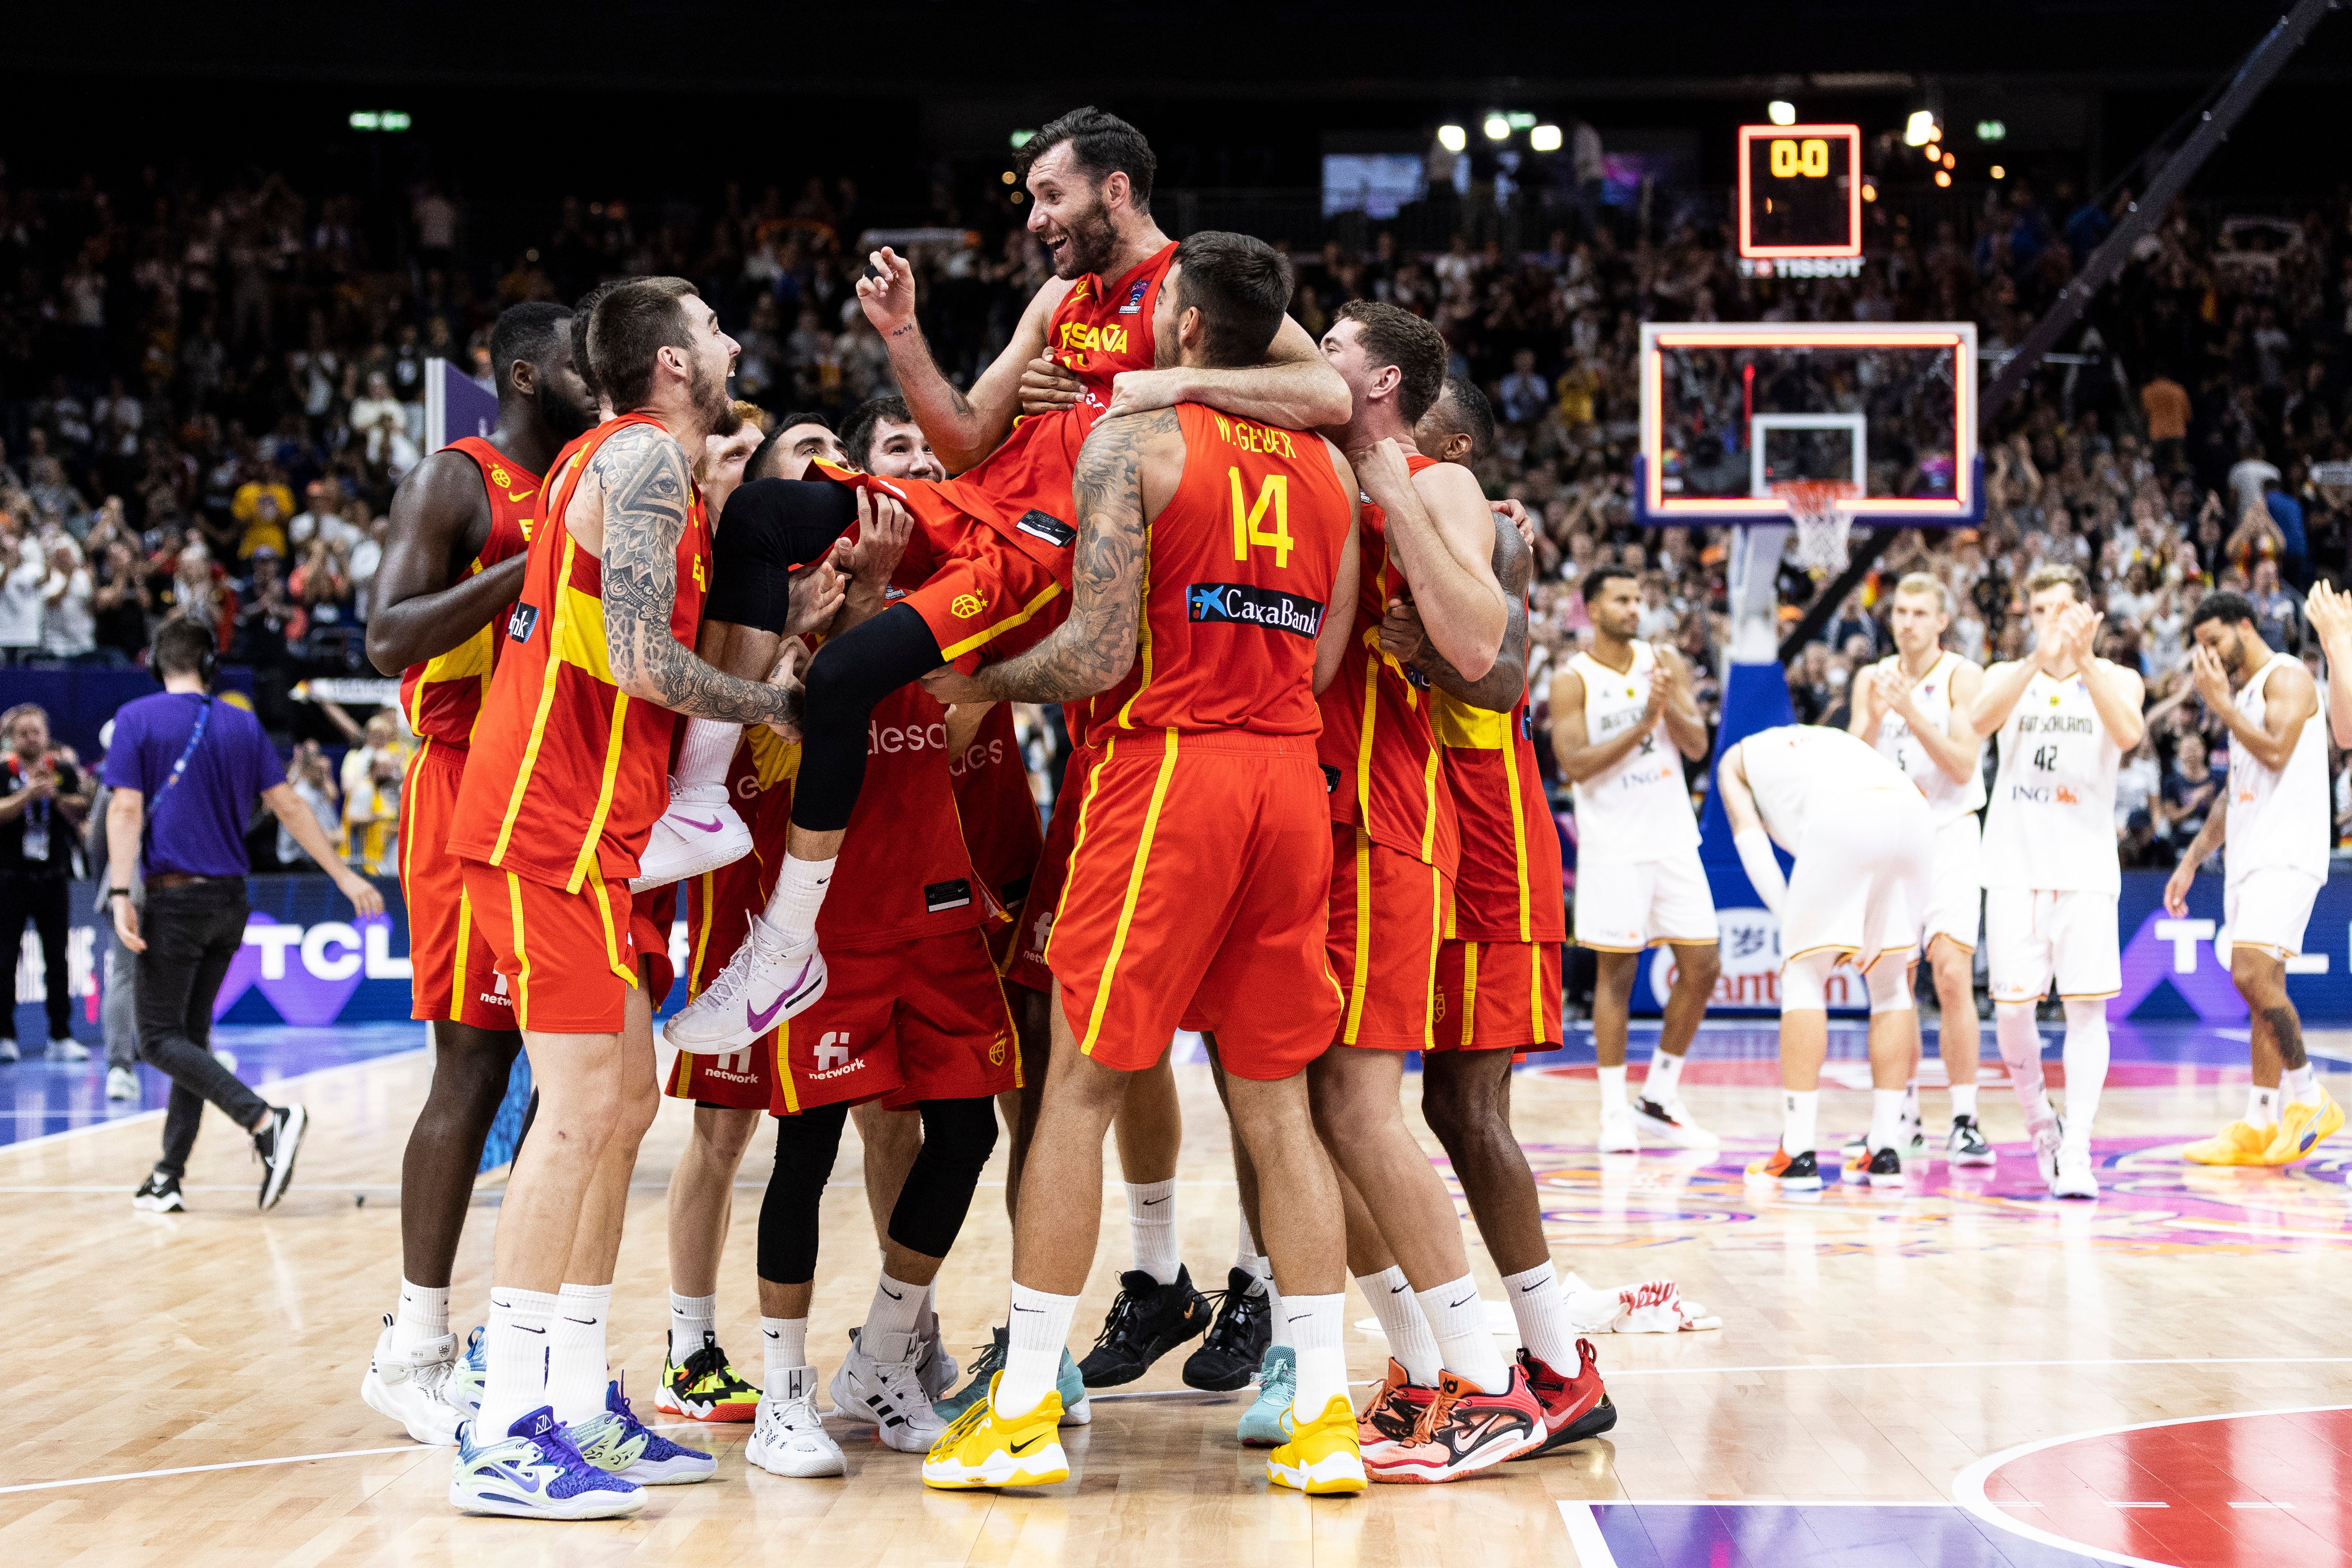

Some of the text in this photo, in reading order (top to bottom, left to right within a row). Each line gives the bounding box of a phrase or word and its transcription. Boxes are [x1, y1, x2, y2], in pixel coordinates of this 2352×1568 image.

[1770, 140, 1829, 178] 0.0
[1774, 257, 1866, 278] TISSOT
[1228, 466, 1294, 569] 14
[868, 720, 947, 755] desa
[2033, 744, 2058, 771] 42
[2012, 784, 2050, 803] ING
[243, 921, 413, 981] TCL
[1023, 950, 1047, 965] netw
[480, 992, 513, 1007] netw
[813, 1031, 850, 1071] fi
[705, 1068, 760, 1084] network
[809, 1058, 866, 1080] network
